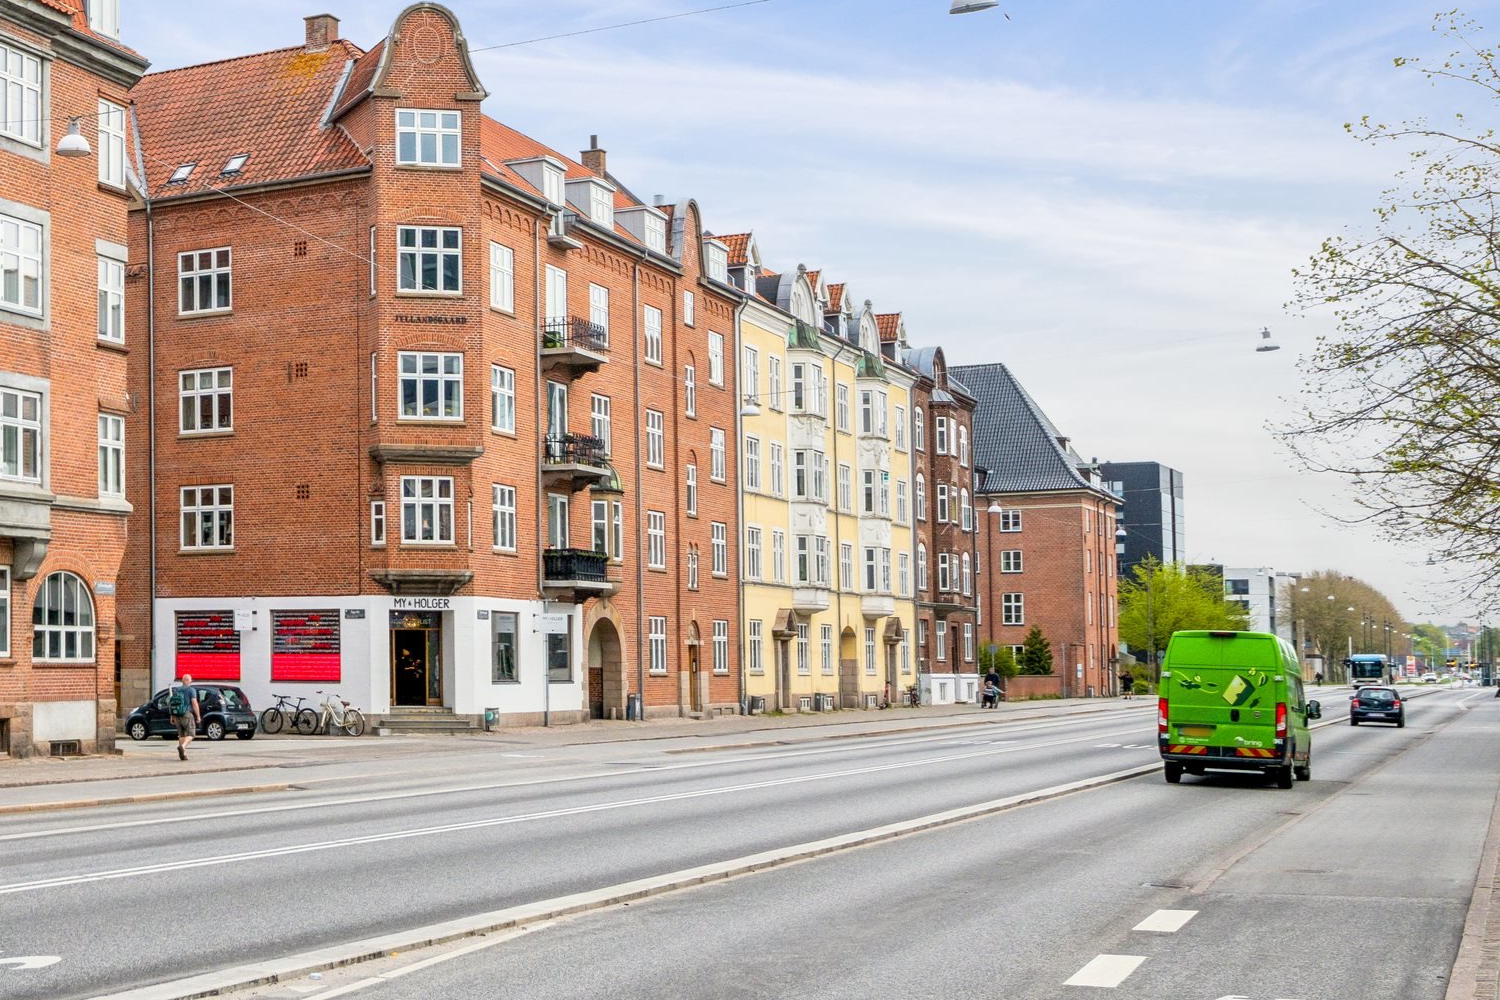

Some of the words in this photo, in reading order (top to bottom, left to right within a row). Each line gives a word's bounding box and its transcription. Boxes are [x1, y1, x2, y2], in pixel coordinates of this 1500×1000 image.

[393, 598, 406, 608] MY
[413, 598, 450, 609] HOLGER
[1243, 739, 1263, 747] bring
